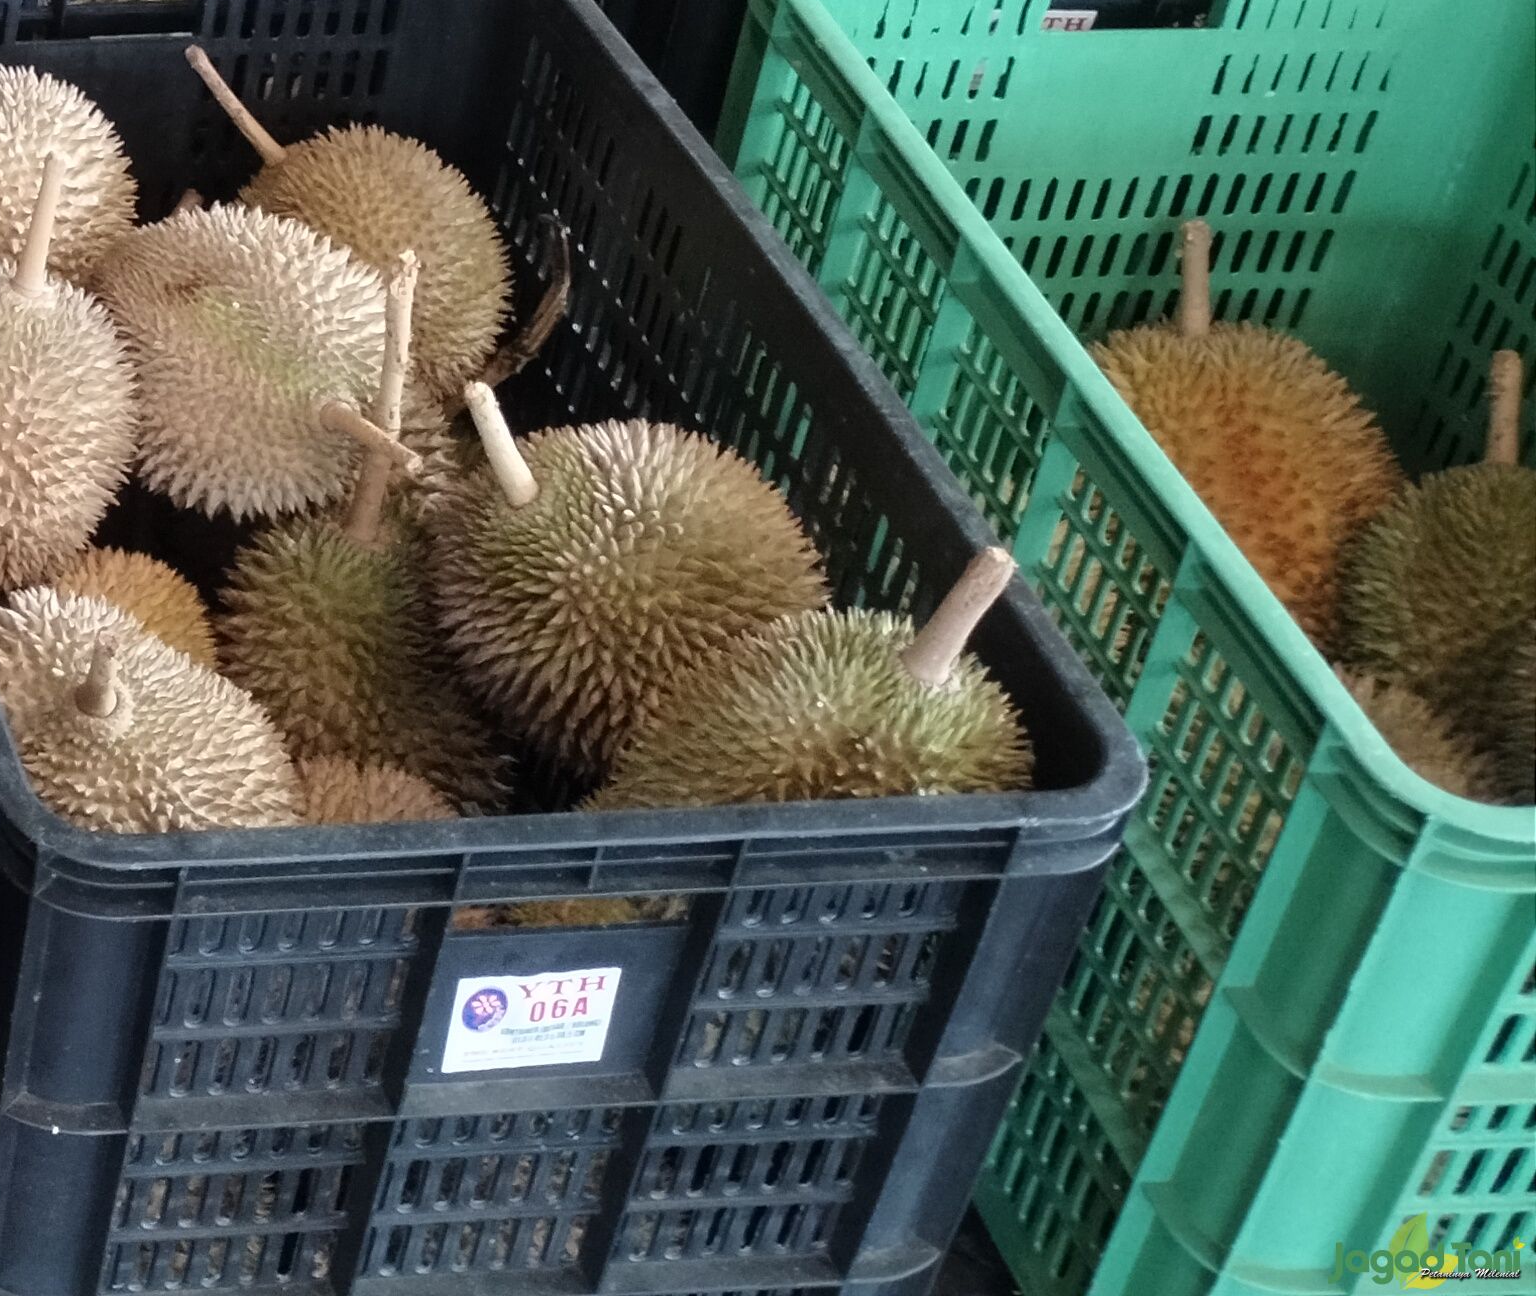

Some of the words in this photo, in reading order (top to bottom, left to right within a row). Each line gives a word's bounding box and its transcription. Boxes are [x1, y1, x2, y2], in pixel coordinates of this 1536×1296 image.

[1042, 17, 1087, 31] TH
[518, 976, 607, 999] YTH
[529, 997, 588, 1022] 06A
